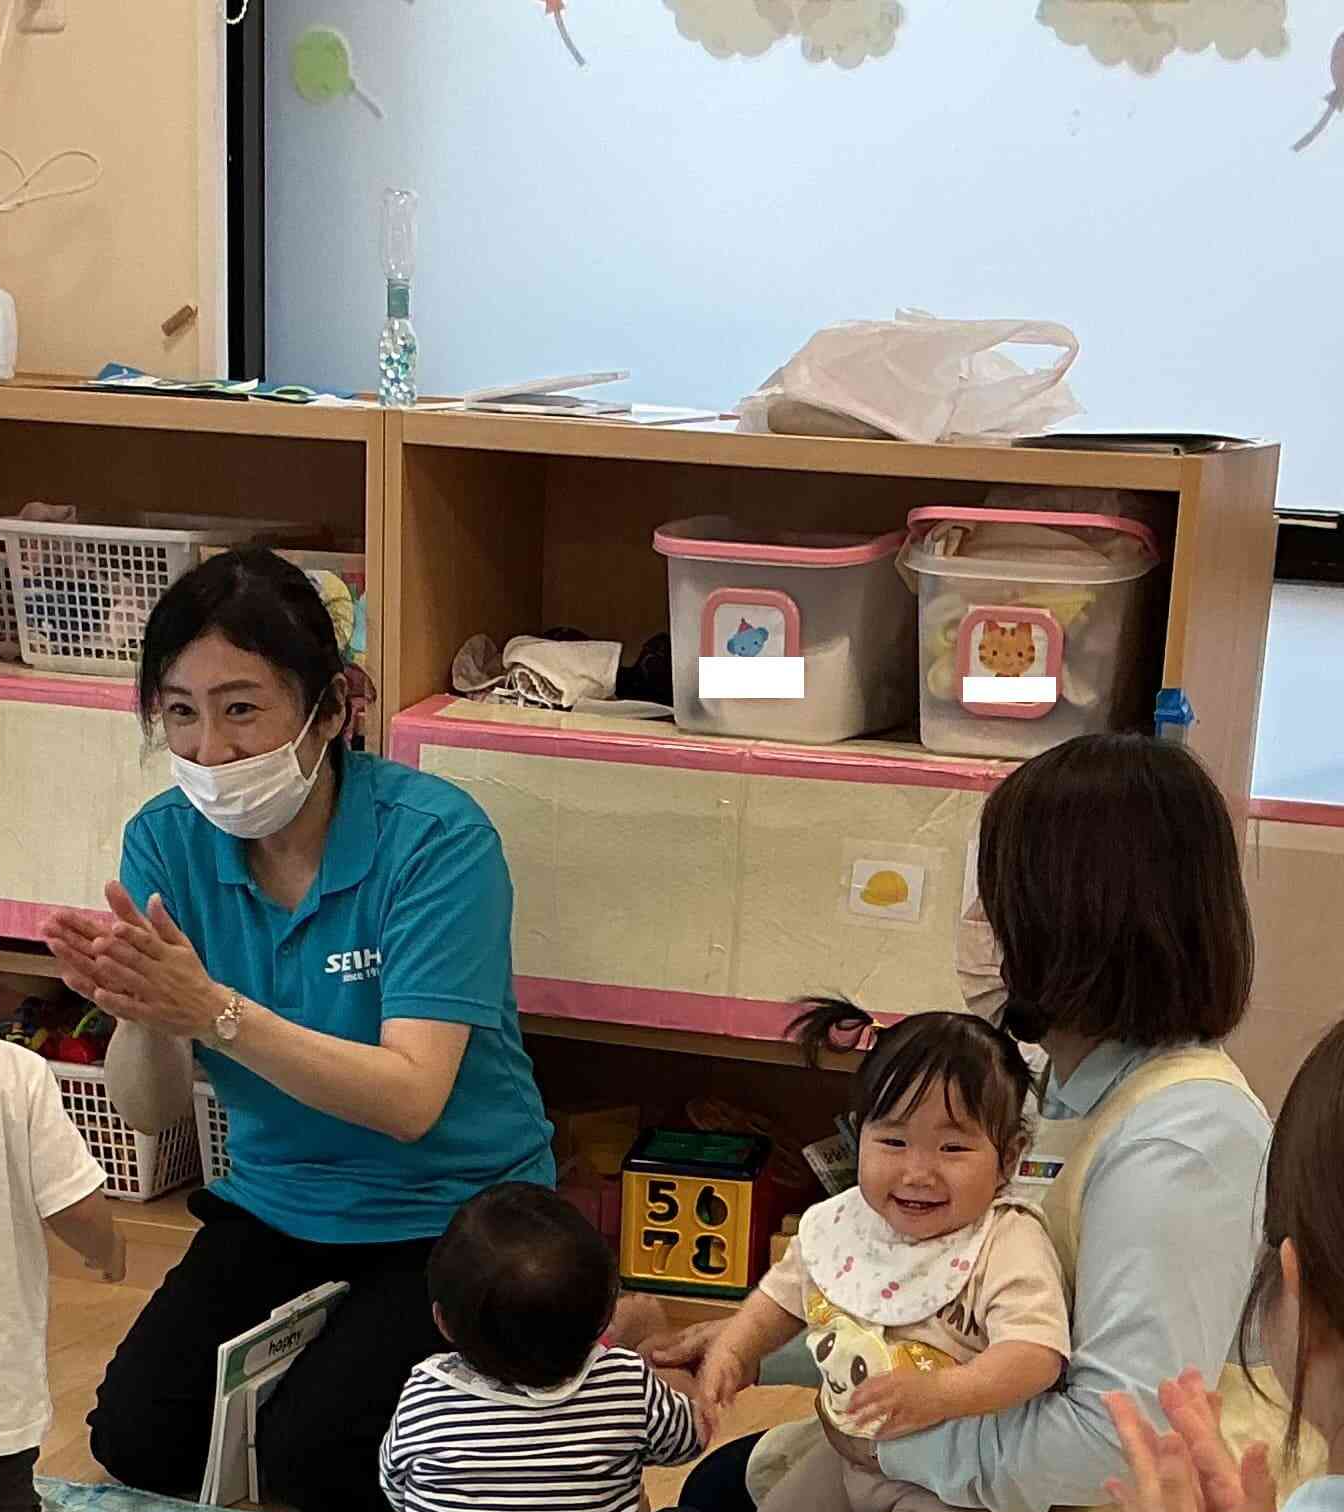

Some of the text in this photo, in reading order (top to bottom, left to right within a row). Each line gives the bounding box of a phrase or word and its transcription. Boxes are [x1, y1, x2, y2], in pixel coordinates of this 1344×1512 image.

[646, 1179, 729, 1229] 5 6
[641, 1227, 729, 1278] 7 8
